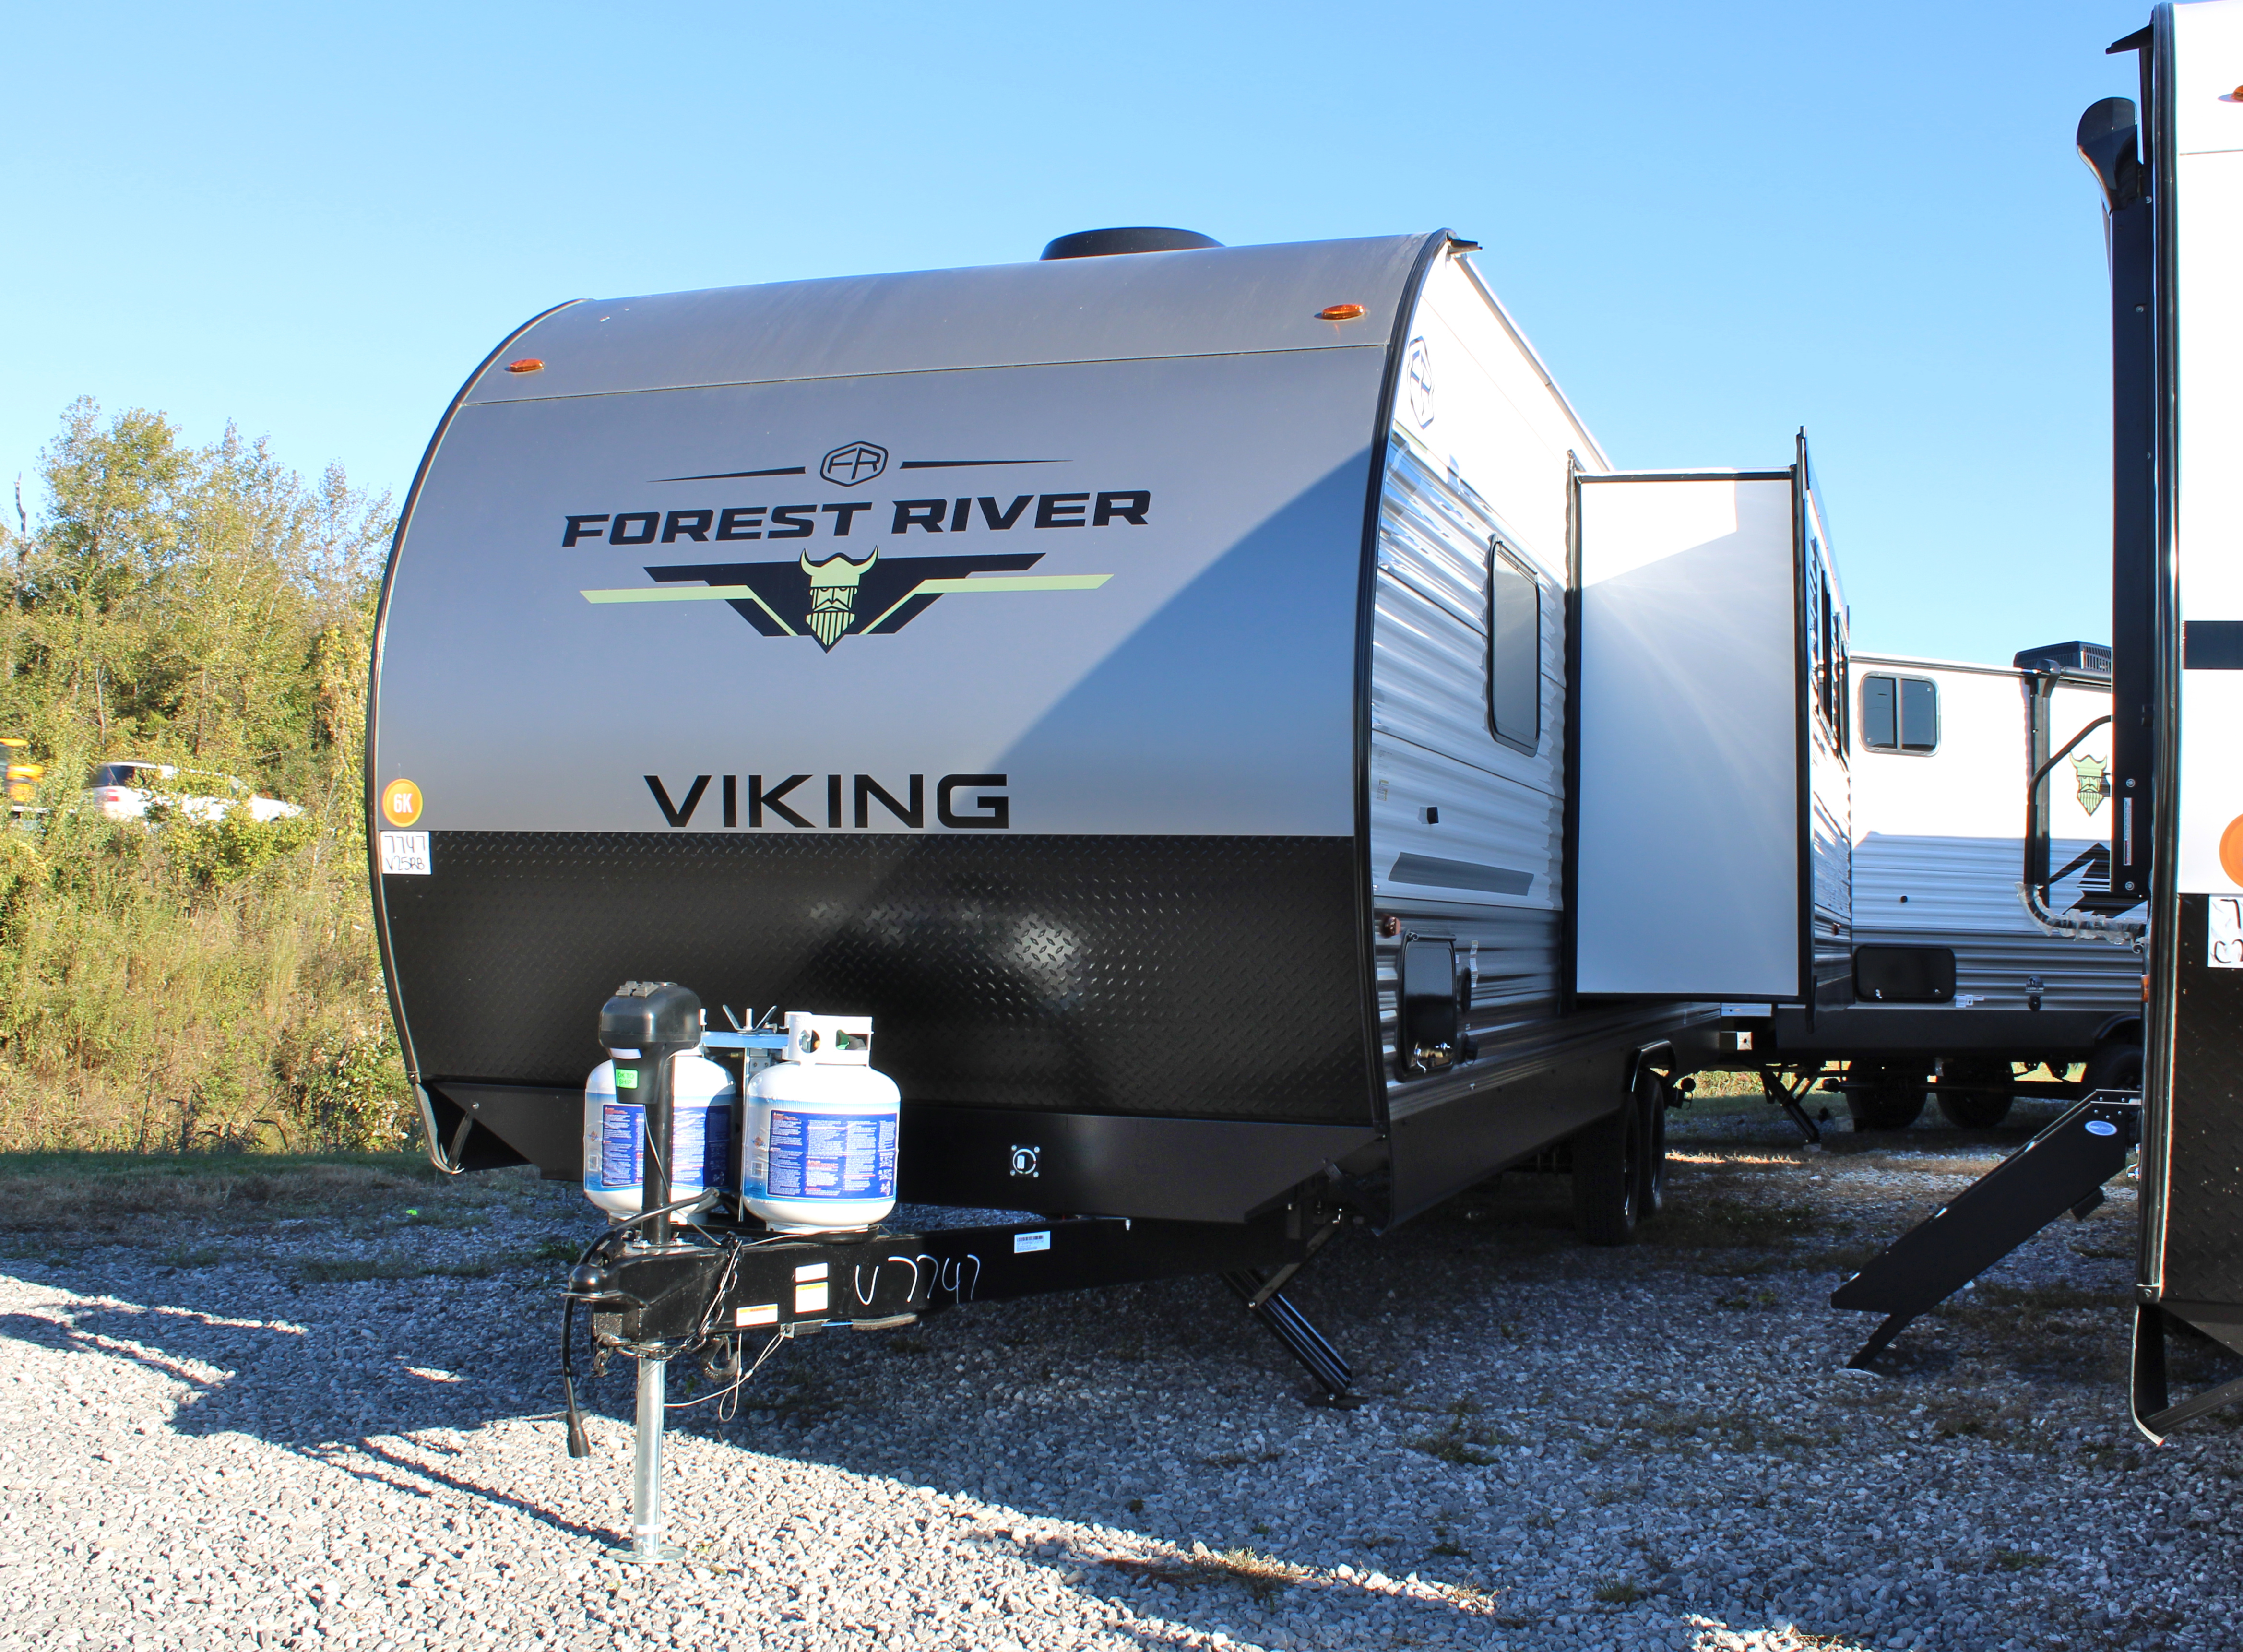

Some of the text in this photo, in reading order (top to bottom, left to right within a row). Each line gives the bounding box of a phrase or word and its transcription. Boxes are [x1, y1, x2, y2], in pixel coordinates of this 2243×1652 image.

[562, 490, 1151, 547] FOREST RIVER
[393, 793, 413, 813] 6K
[643, 774, 1009, 829] VIKING
[384, 835, 426, 854] 7747
[888, 1254, 980, 1304] 7747
